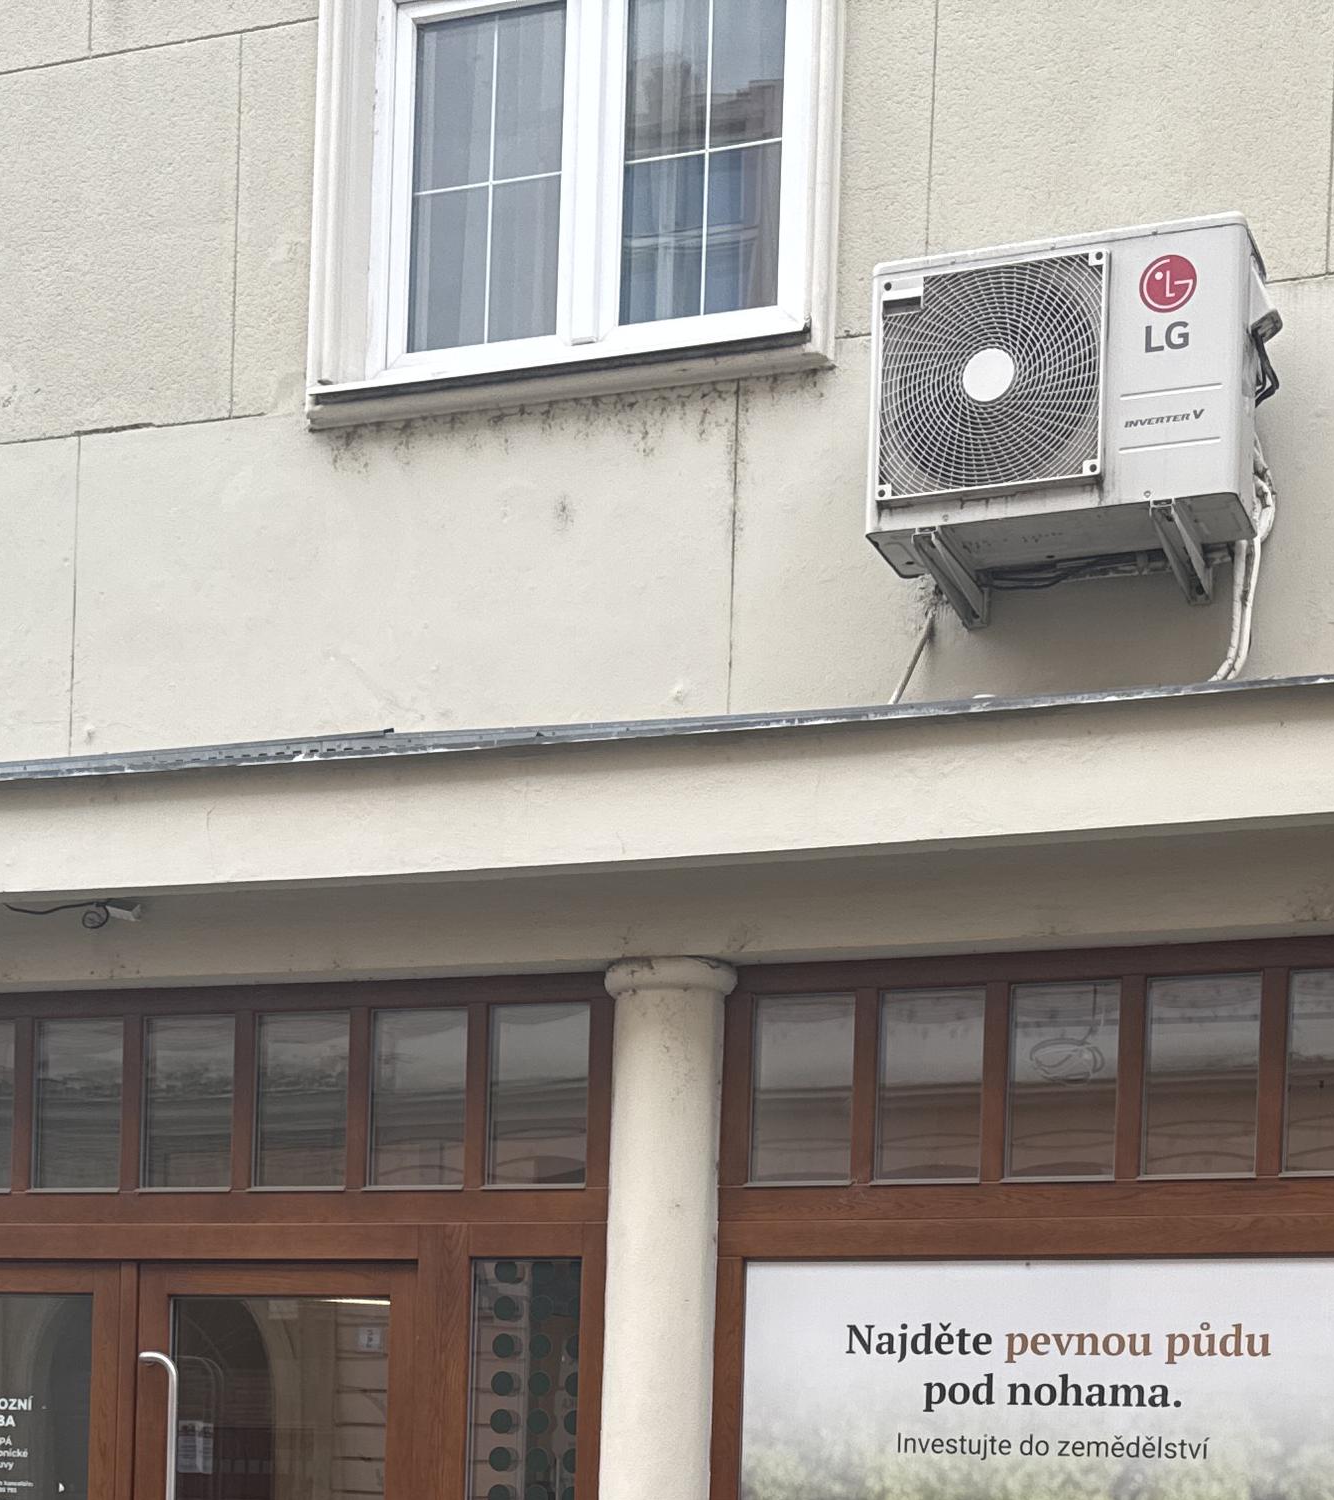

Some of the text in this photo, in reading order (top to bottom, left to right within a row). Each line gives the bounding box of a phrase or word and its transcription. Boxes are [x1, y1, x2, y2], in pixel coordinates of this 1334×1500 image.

[1145, 321, 1189, 353] LG
[1124, 409, 1205, 428] INVERTER V
[845, 1321, 1271, 1365] Najděte pevnou půdu
[922, 1373, 1183, 1412] pod nohama.
[0, 1435, 12, 1446] PÁ
[896, 1432, 1210, 1461] Investujte do zemědělství
